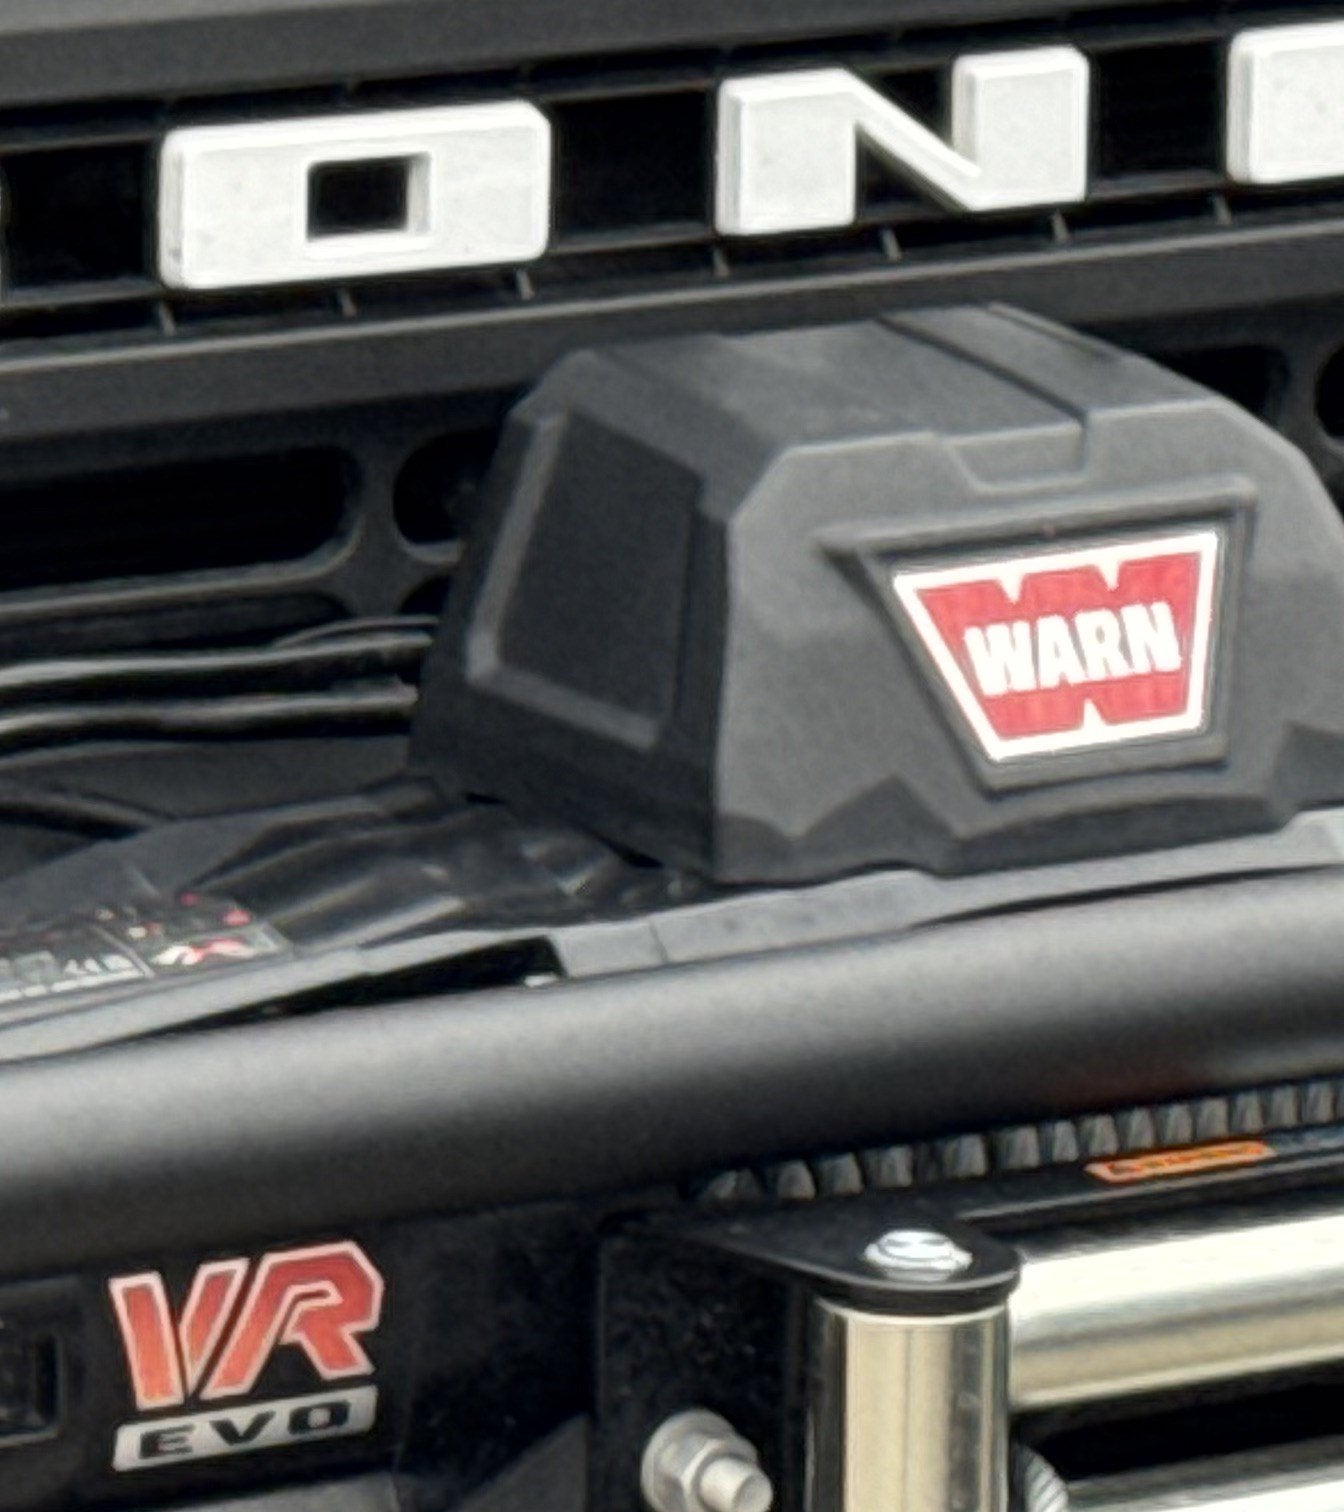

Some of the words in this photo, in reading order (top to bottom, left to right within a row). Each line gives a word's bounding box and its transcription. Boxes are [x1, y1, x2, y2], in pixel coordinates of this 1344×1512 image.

[963, 600, 1182, 697] WARN
[108, 1239, 386, 1412] VR
[138, 1400, 352, 1461] EVO
